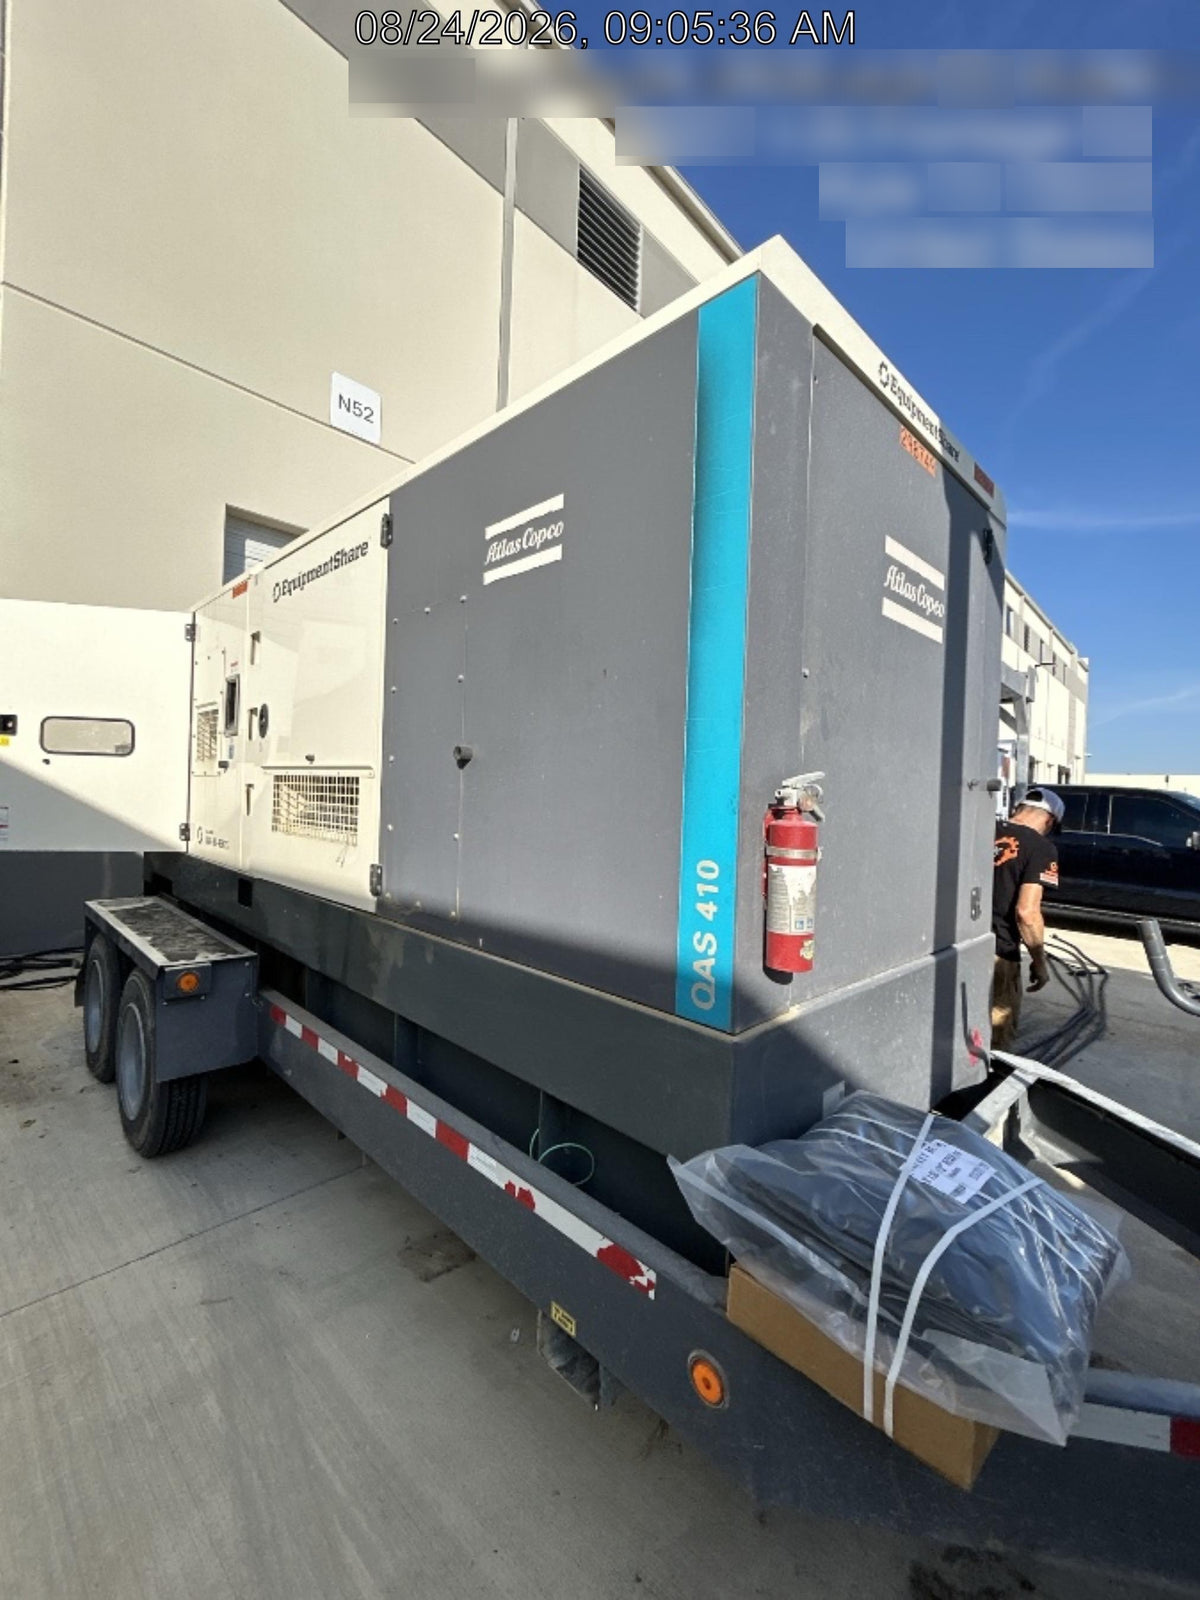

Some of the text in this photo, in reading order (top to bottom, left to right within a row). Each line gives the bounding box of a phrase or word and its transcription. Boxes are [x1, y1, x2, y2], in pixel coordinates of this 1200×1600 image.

[338, 393, 375, 424] N52
[281, 541, 369, 597] EquipmentShare
[484, 520, 564, 566] Atlas Copco
[883, 565, 945, 618] Atlas Copco
[691, 859, 720, 1010] QAS 410
